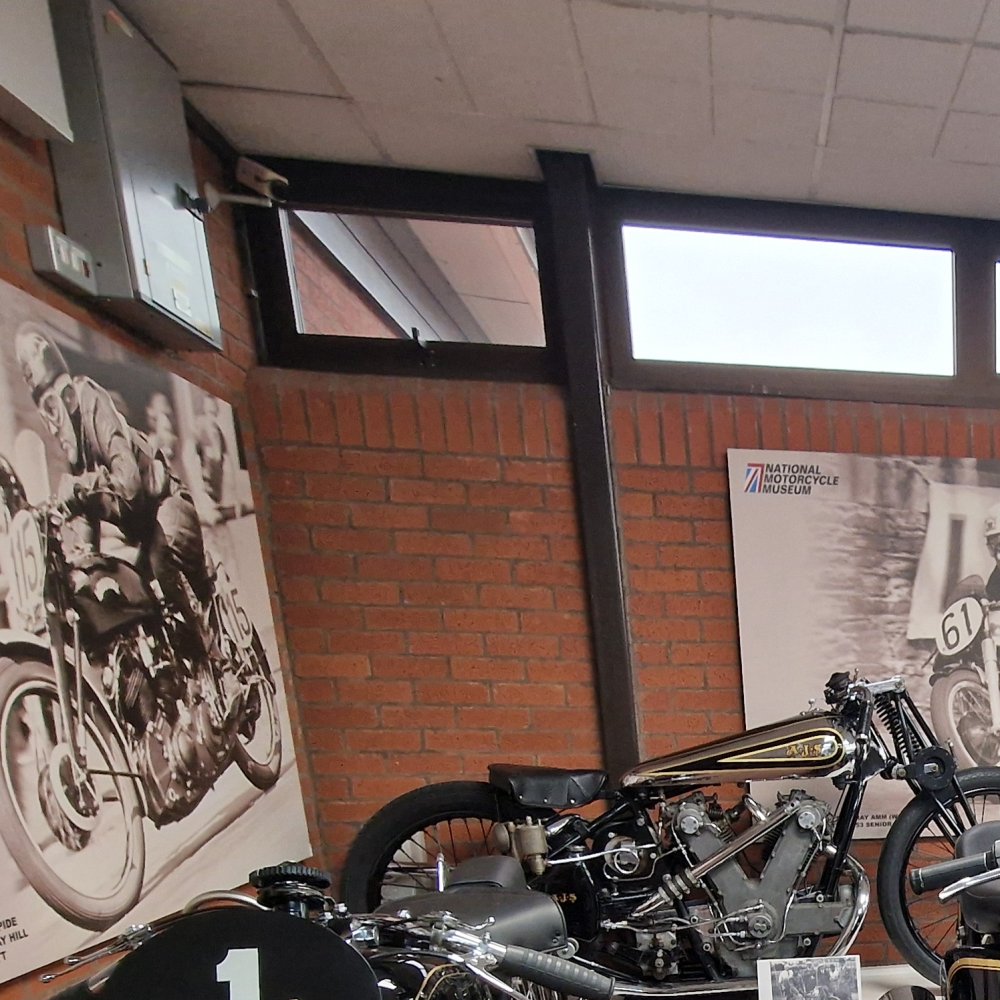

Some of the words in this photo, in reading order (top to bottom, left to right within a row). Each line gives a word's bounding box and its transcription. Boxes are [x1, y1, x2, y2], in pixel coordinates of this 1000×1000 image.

[765, 464, 821, 475] NATIONAL
[763, 474, 839, 486] MOTORCYCLE
[762, 484, 812, 495] MUSEUM
[941, 602, 973, 650] 61
[9, 929, 29, 943] HILL
